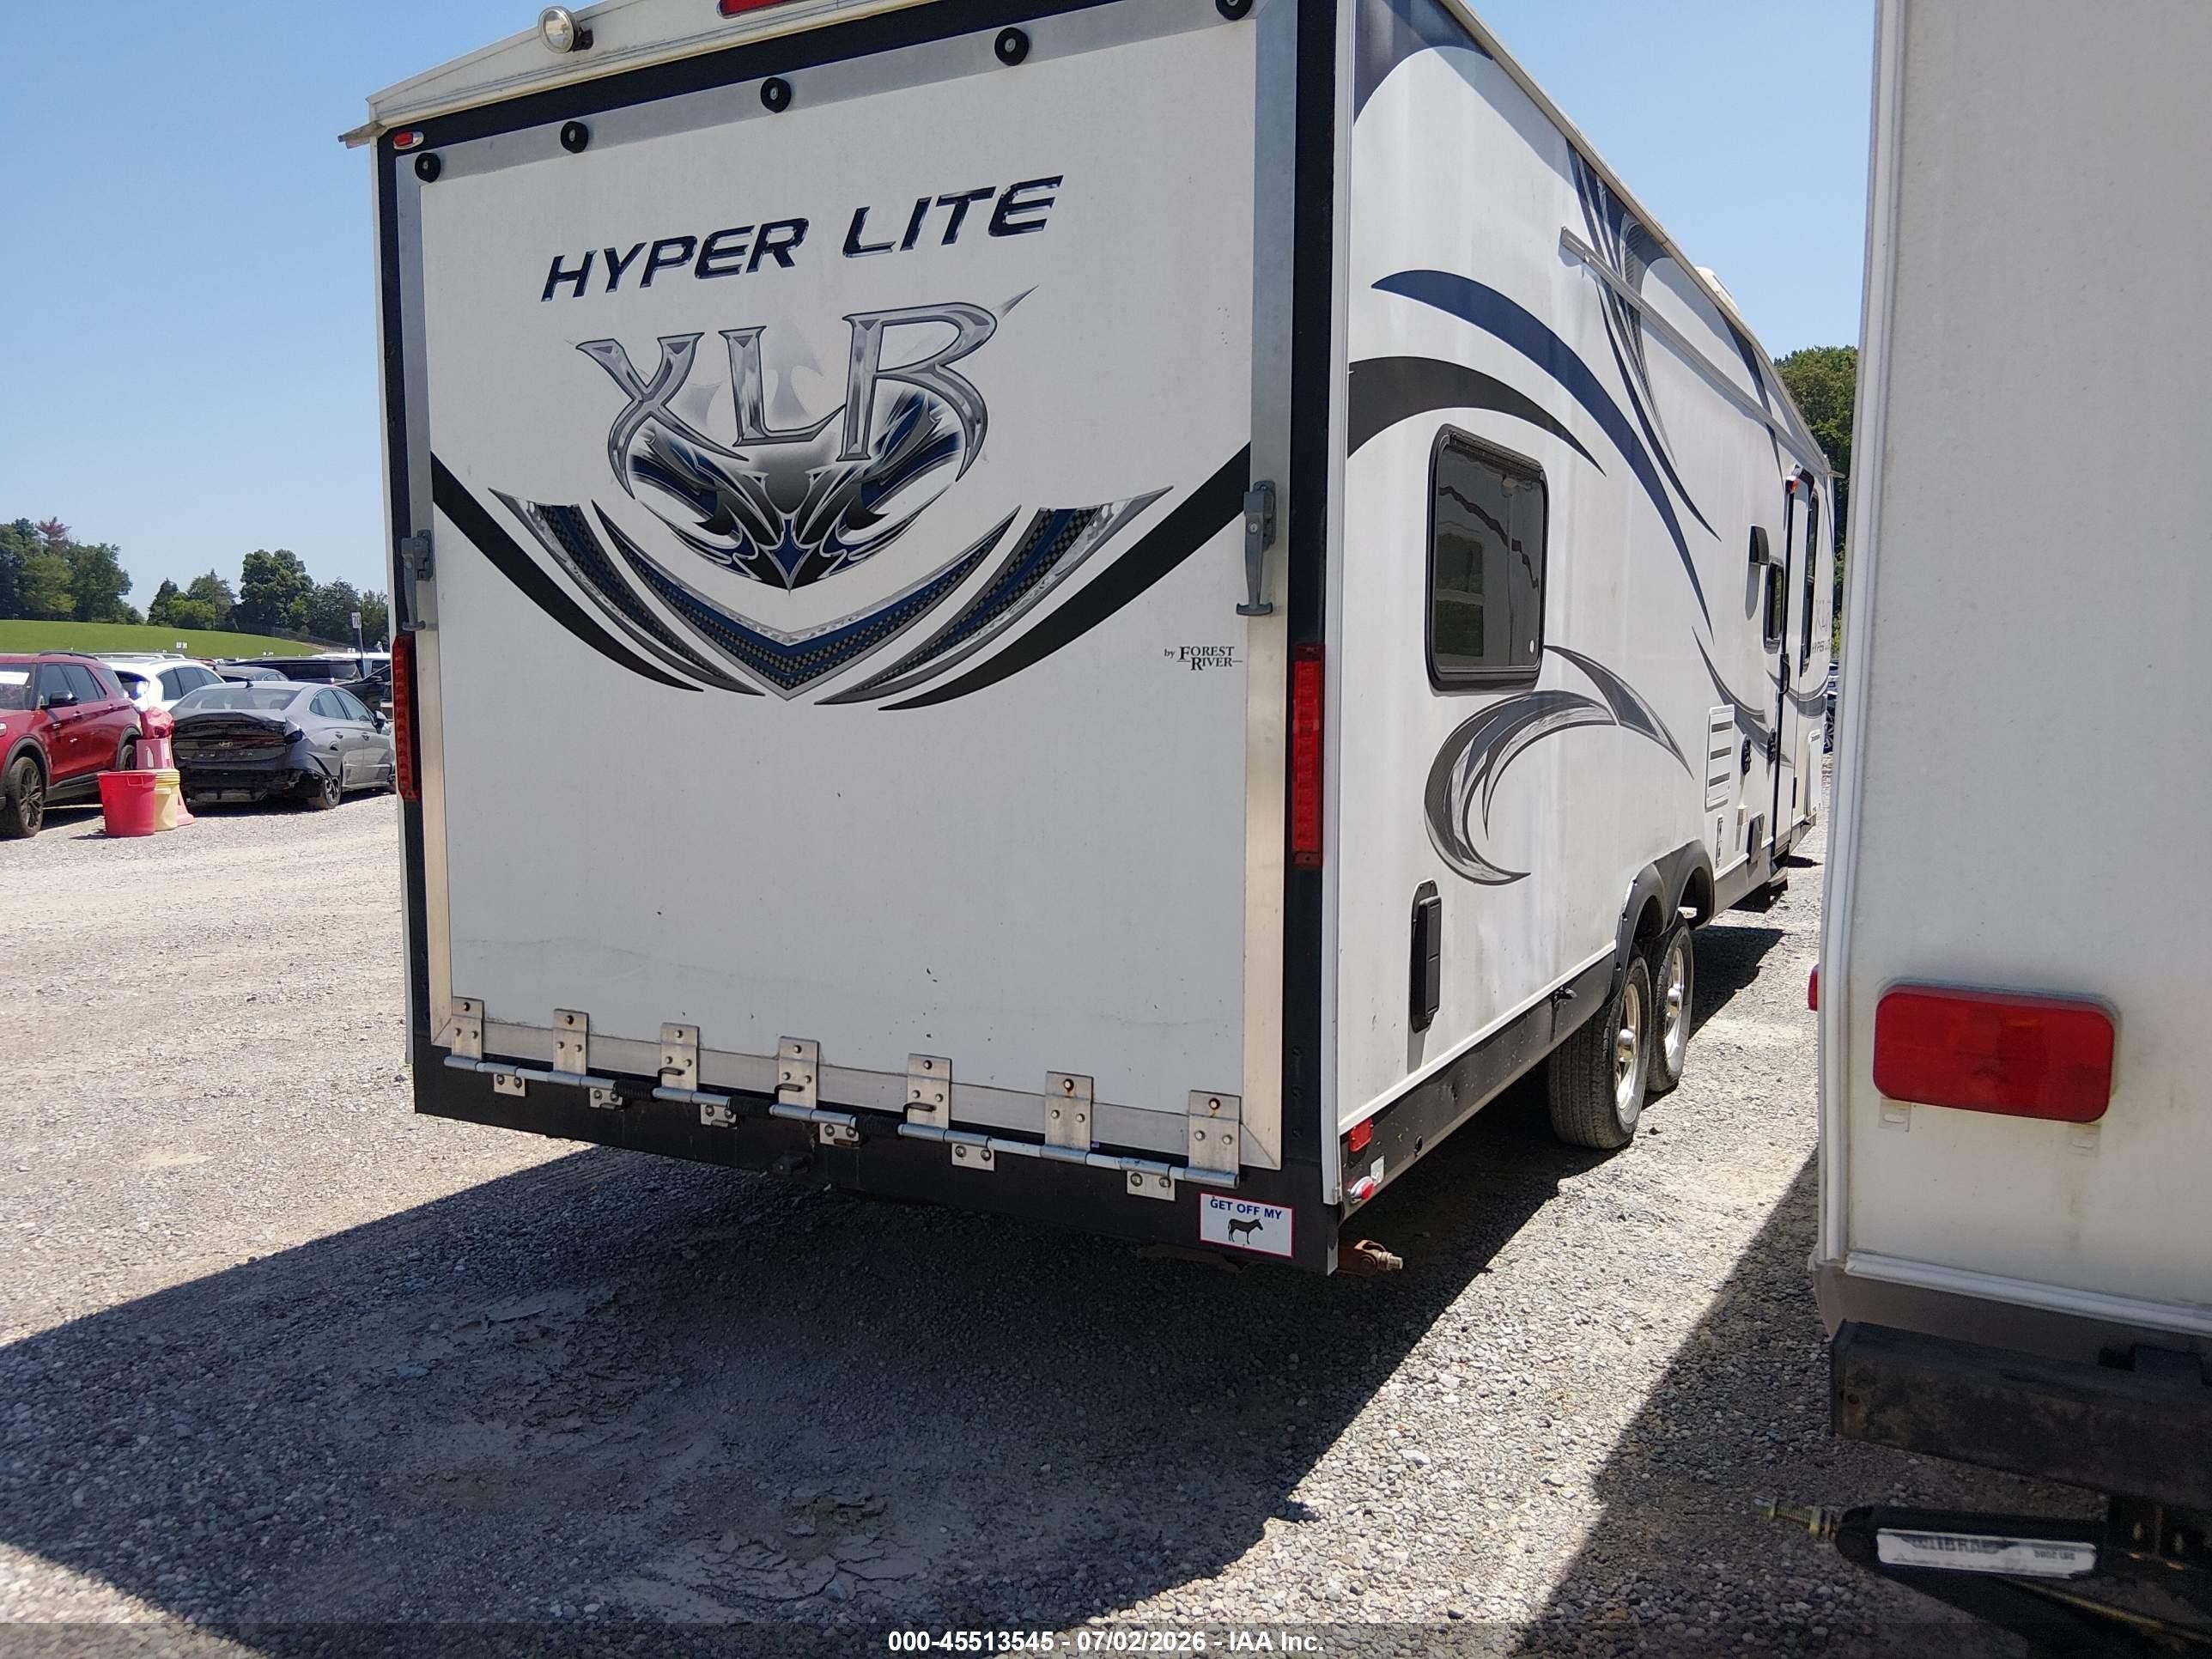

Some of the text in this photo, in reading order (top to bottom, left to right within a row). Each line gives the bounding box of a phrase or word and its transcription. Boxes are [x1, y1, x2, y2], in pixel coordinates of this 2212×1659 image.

[540, 174, 1064, 303] HYPER LITE
[574, 301, 999, 500] XLR
[352, 615, 362, 626] 70
[1164, 646, 1235, 660] by FOREST
[1190, 657, 1233, 671] RIVER
[1210, 1199, 1282, 1219] GET OFF MY
